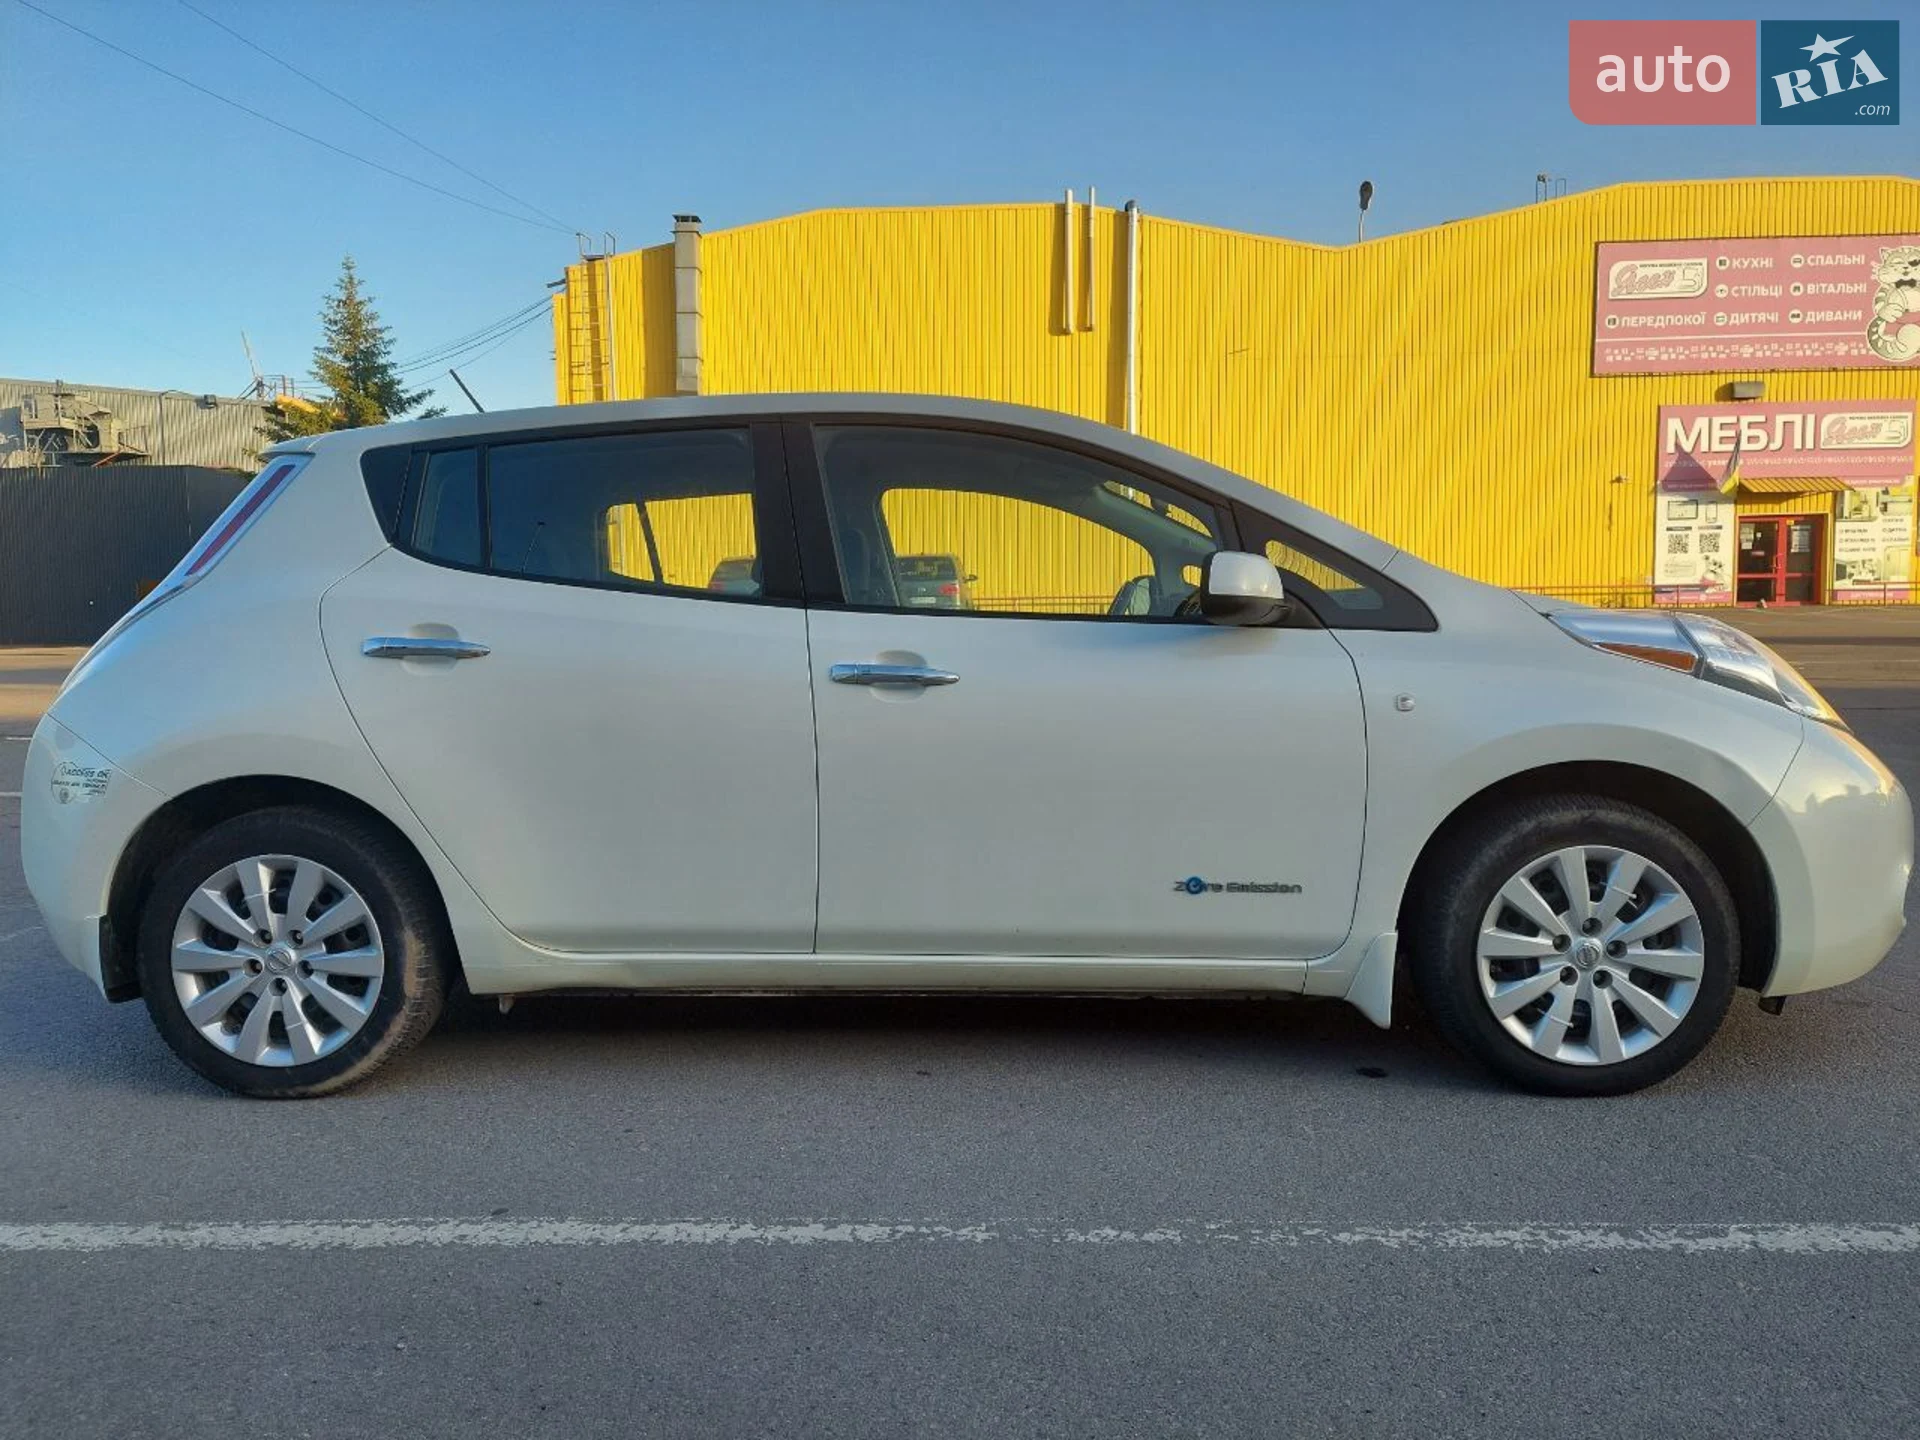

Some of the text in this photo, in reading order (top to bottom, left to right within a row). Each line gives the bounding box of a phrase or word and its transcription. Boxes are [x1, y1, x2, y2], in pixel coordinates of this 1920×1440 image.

[1732, 257, 1773, 269] КУХНІ
[1807, 254, 1866, 266] СПАЛЬНІ
[1731, 284, 1783, 298] СТІЛЬЦІ
[1806, 282, 1867, 295] ВІТАЛЬНІ
[1621, 312, 1707, 328] ПЕРЕДПОКОЇ
[1729, 312, 1779, 326] ДИТЯЧІ
[1805, 310, 1863, 324] ДИВАНИ
[1667, 413, 1816, 454] МЕБЛІ
[1226, 881, 1303, 893] Emission
